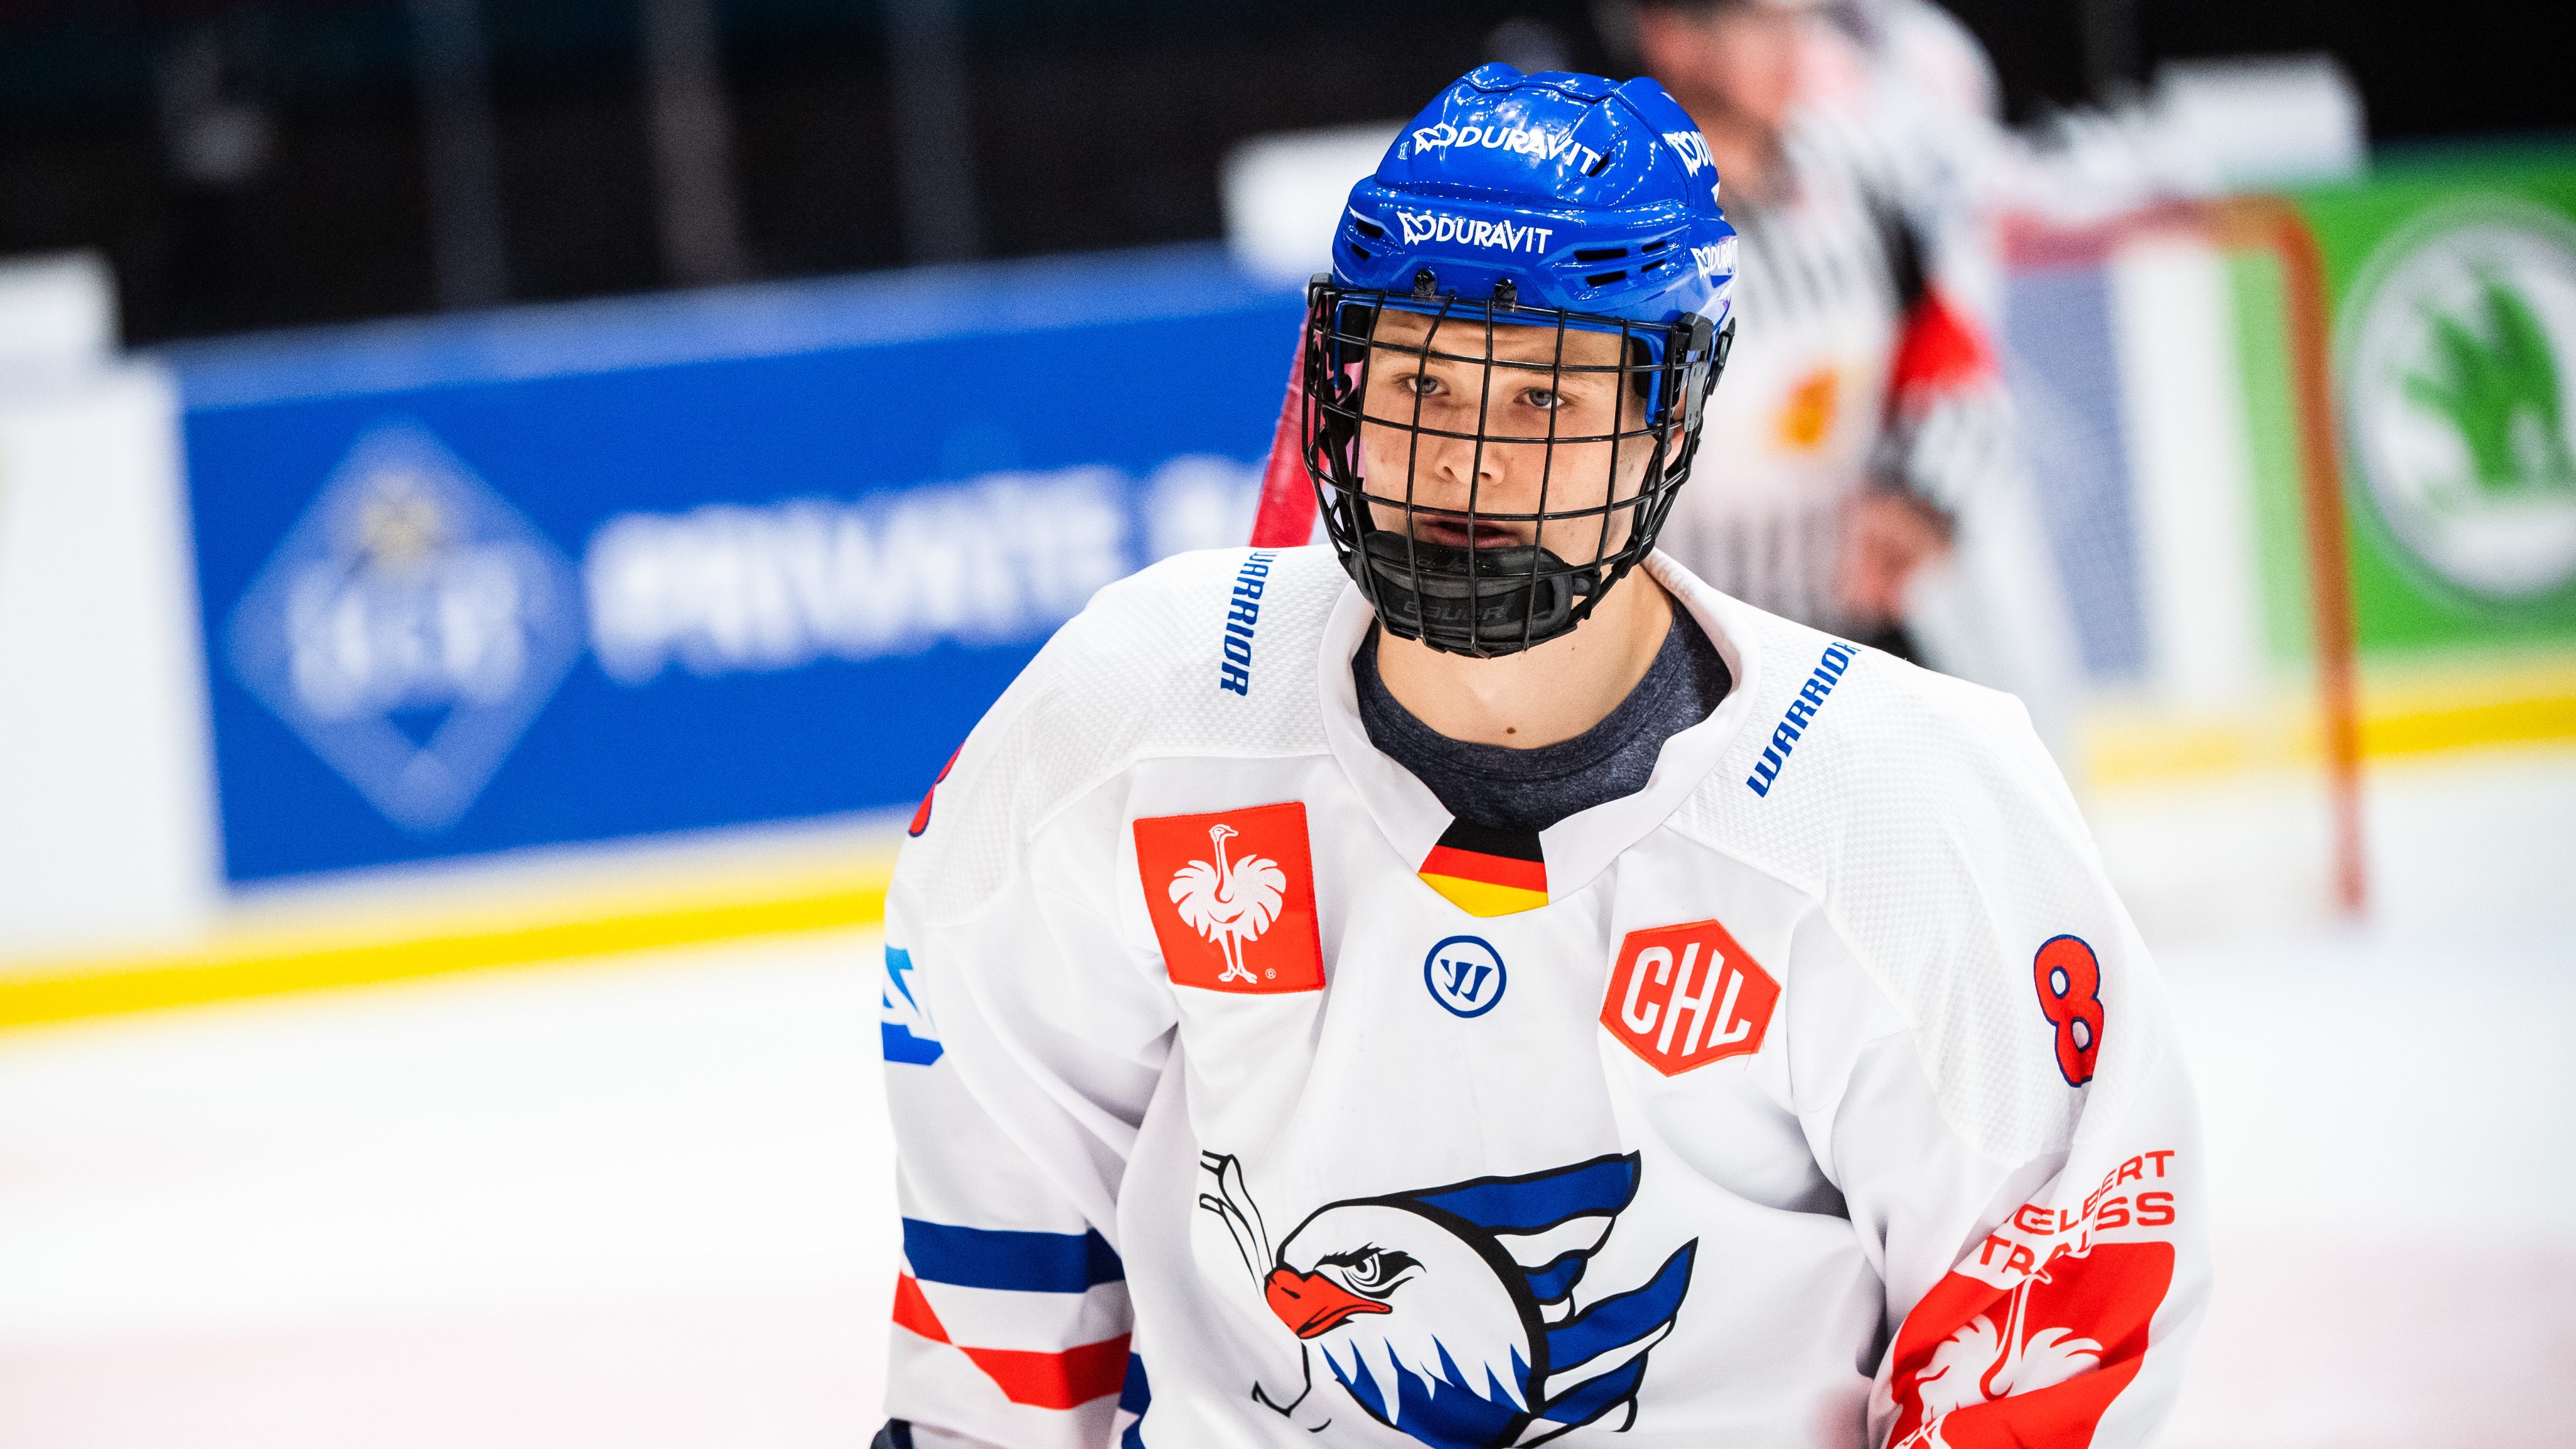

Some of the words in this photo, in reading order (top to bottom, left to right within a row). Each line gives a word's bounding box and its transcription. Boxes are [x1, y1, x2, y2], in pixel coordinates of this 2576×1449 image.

[1455, 126, 1601, 174] DURAVIT
[1436, 216, 1553, 254] DURAVIT
[1220, 551, 1280, 696] WARRIOR
[1746, 641, 1862, 798] WARRIOR
[1621, 942, 1752, 1057] CHL
[2034, 934, 2104, 1088] 8
[1979, 1191, 2175, 1277] TRAUSS
